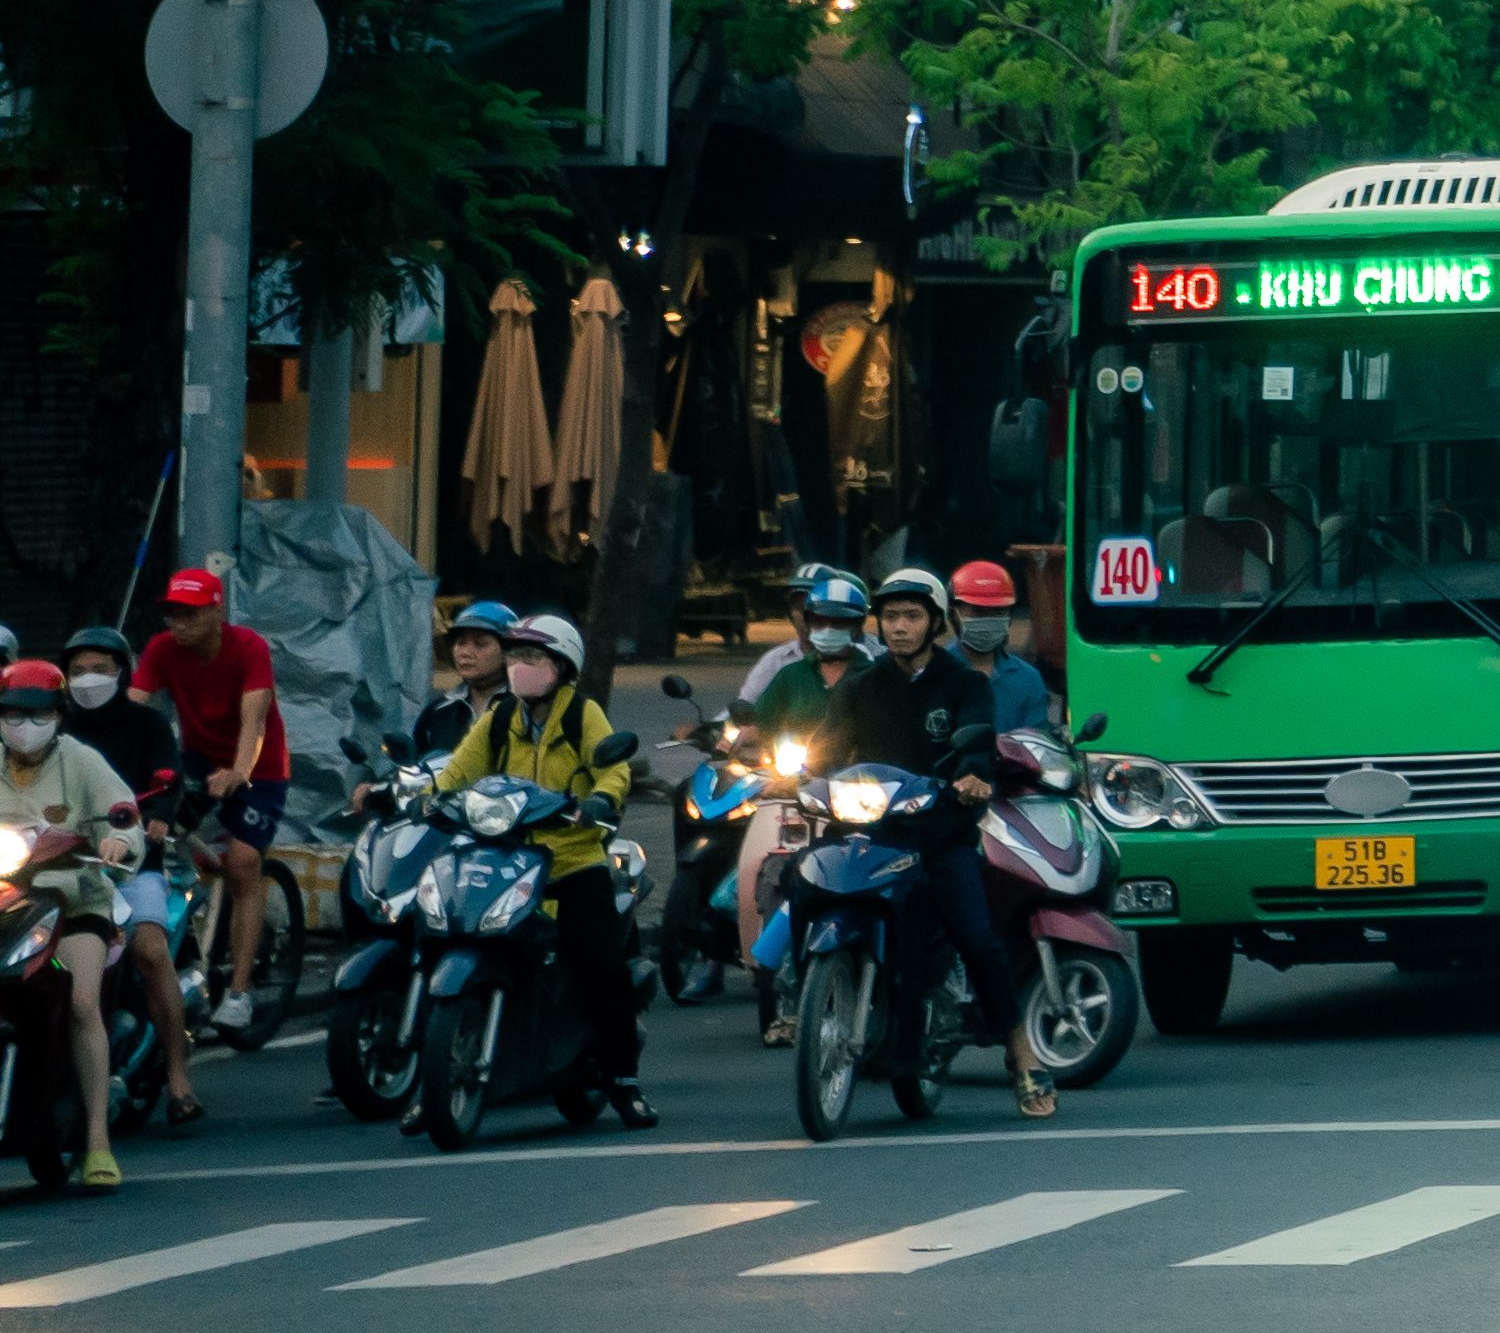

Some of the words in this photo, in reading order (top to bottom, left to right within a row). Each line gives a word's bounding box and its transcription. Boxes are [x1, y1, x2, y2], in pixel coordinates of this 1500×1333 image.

[1130, 262, 1220, 313] 140
[1258, 263, 1342, 310] KHU
[1353, 262, 1491, 308] CHUNG
[1099, 544, 1151, 596] 140
[1343, 839, 1387, 862] 51B
[1326, 863, 1404, 886] 225.36
